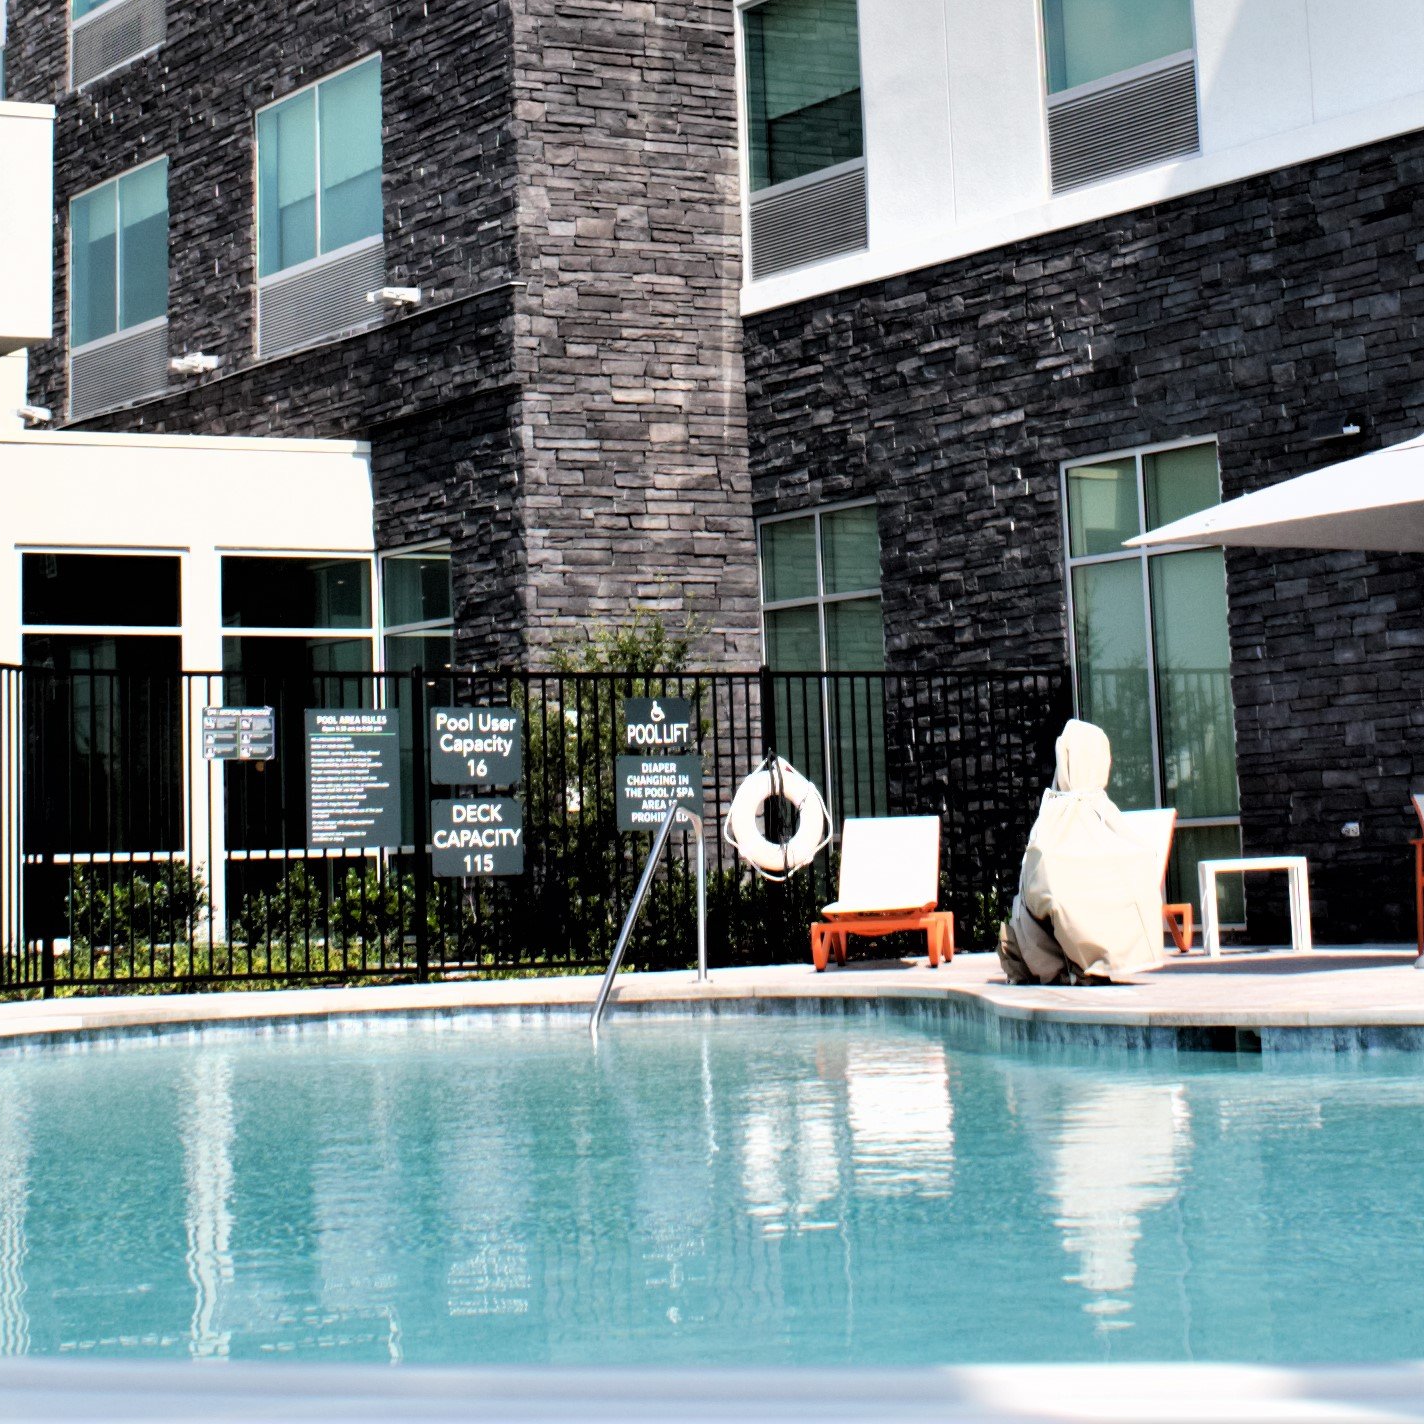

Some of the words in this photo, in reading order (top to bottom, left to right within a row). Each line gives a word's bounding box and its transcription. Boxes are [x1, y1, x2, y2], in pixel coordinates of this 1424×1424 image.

[316, 715, 337, 725] POOL
[339, 715, 360, 725] AREA
[361, 715, 387, 725] RULES
[436, 713, 473, 731] Pool
[478, 714, 516, 731] User
[627, 723, 662, 745] POOL
[663, 723, 689, 744] LIFT
[439, 734, 513, 757] Capacity
[467, 759, 488, 777] 16
[641, 762, 677, 773] DIAPER
[627, 774, 676, 786] CHANGING
[678, 774, 689, 785] IN
[624, 787, 642, 798] THE
[645, 787, 669, 798] POOL
[676, 787, 694, 798] SPA
[452, 804, 503, 823] DECK
[642, 799, 666, 810] AREA
[631, 811, 689, 823] PROHIBED
[433, 829, 521, 848] CAPACITY
[463, 854, 494, 873] 115
